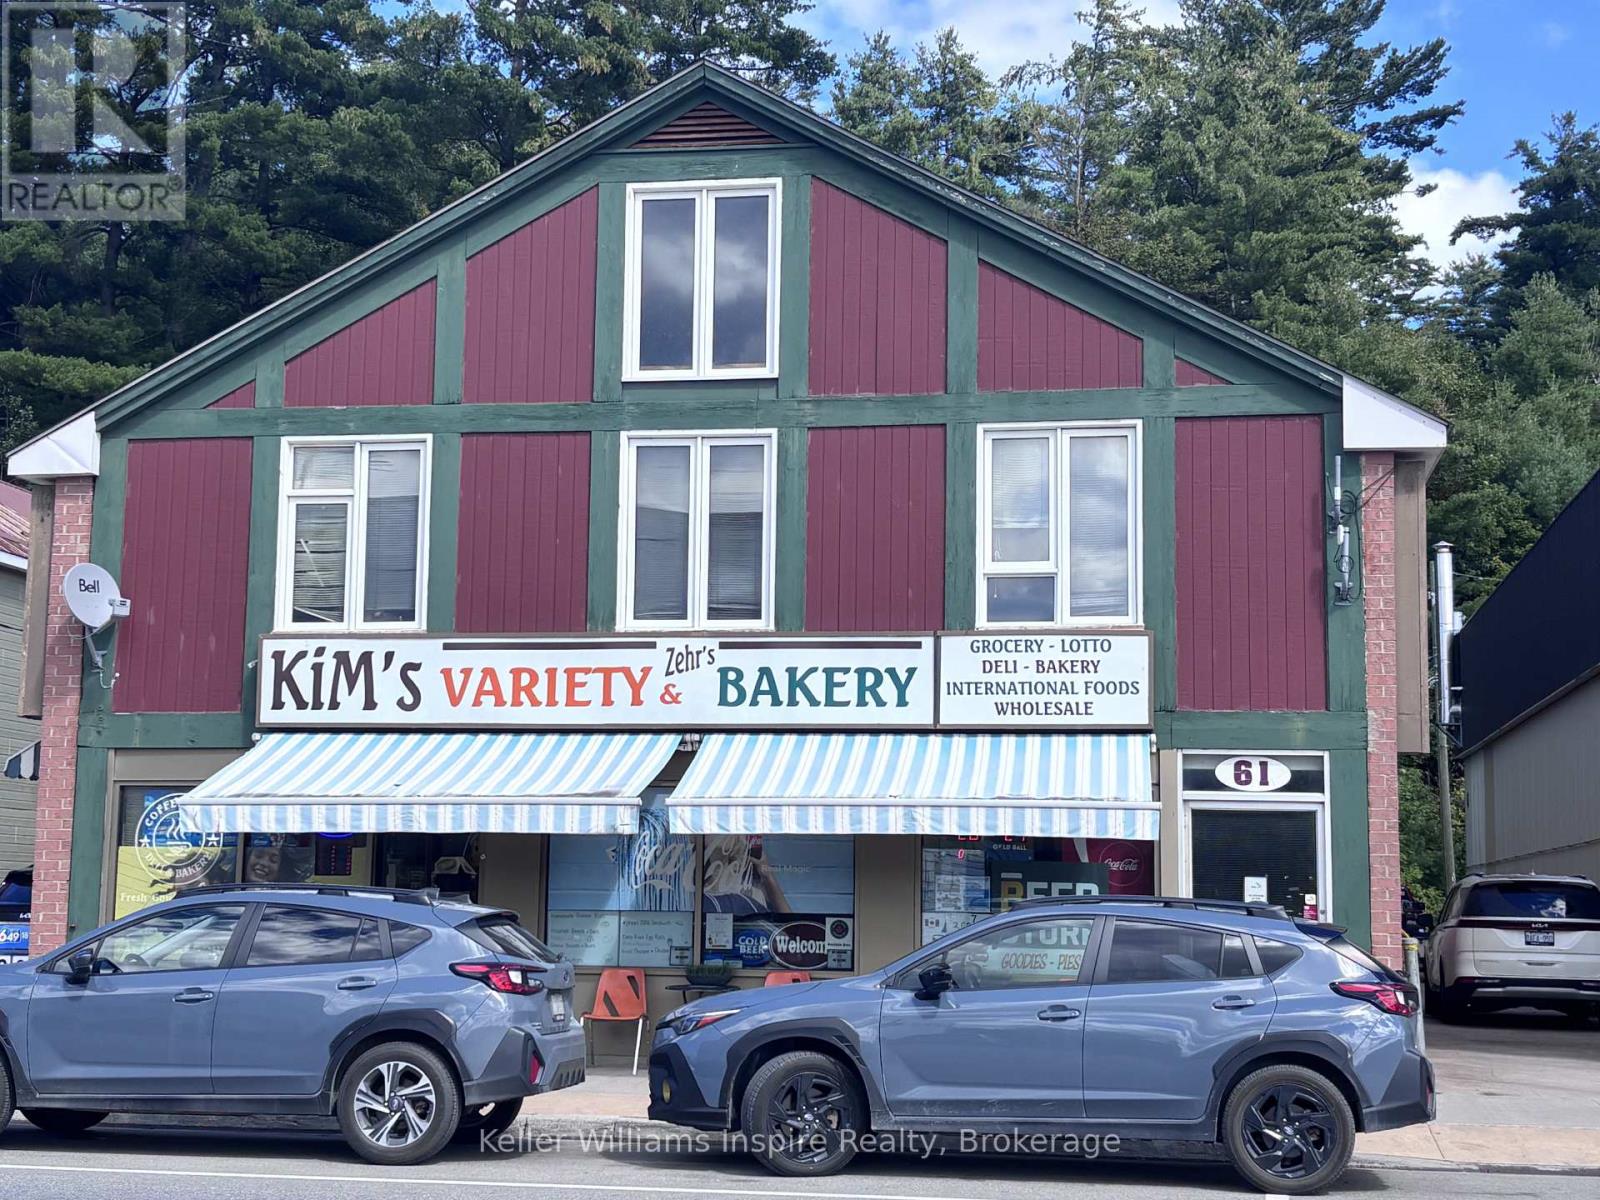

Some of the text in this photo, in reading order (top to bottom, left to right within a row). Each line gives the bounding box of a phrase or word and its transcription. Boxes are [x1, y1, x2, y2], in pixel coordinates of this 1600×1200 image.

[78, 578, 100, 593] Bell
[970, 639, 1044, 653] GROCERY
[1061, 639, 1112, 653] LOTTO
[664, 644, 716, 677] Zehr's
[982, 660, 1018, 674] DELI
[1035, 660, 1101, 674] BAKERY
[440, 666, 653, 707] VARIETY
[660, 683, 682, 705] &
[717, 666, 918, 708] BAKERY
[946, 681, 1140, 696] INTERNATIONAL FOODS
[994, 701, 1094, 716] WHOLESALE
[1233, 759, 1269, 786] 61
[145, 797, 181, 827] COFFE
[175, 850, 212, 878] BAKERY
[738, 935, 767, 945] COLD
[776, 935, 828, 954] Welcom
[739, 945, 764, 954] BEER
[1001, 953, 1048, 969] GOODIES
